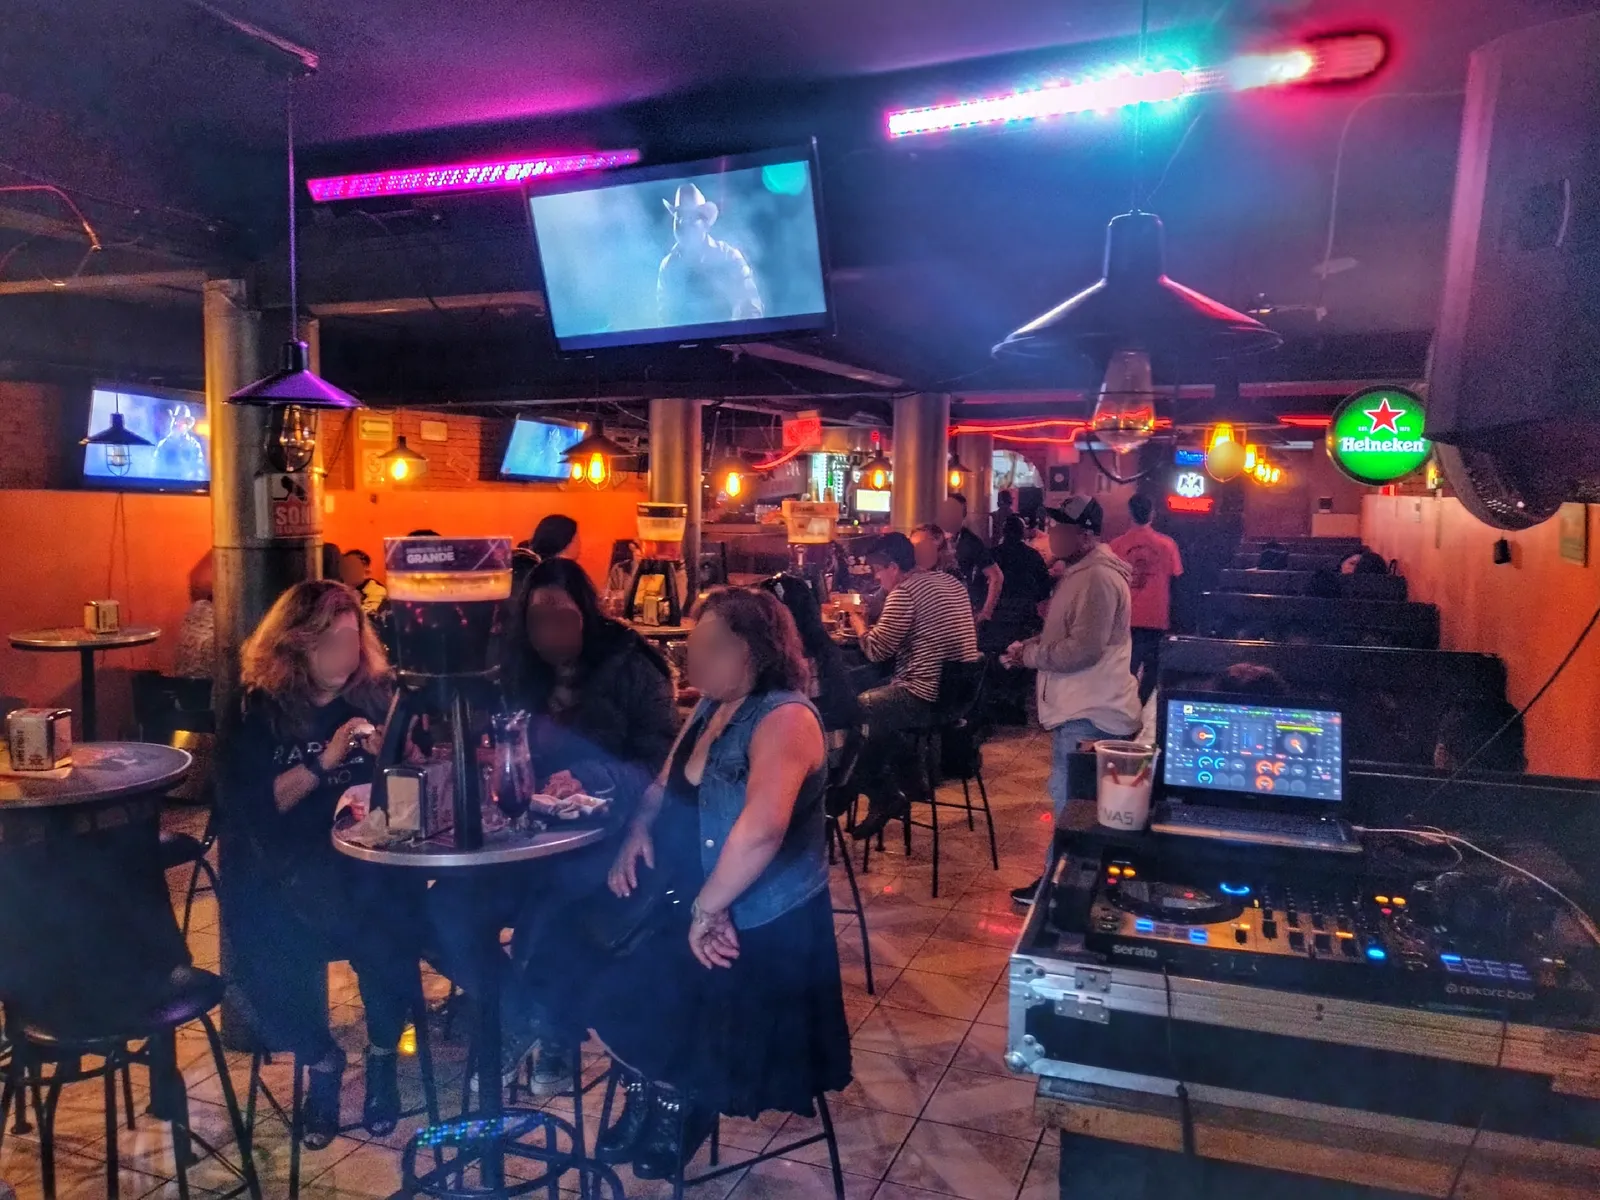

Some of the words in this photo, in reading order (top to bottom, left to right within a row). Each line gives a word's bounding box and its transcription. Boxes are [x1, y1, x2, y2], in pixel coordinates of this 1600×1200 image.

[1341, 436, 1425, 452] Heineken
[407, 552, 454, 564] GRANDE
[1112, 944, 1158, 958] serato
